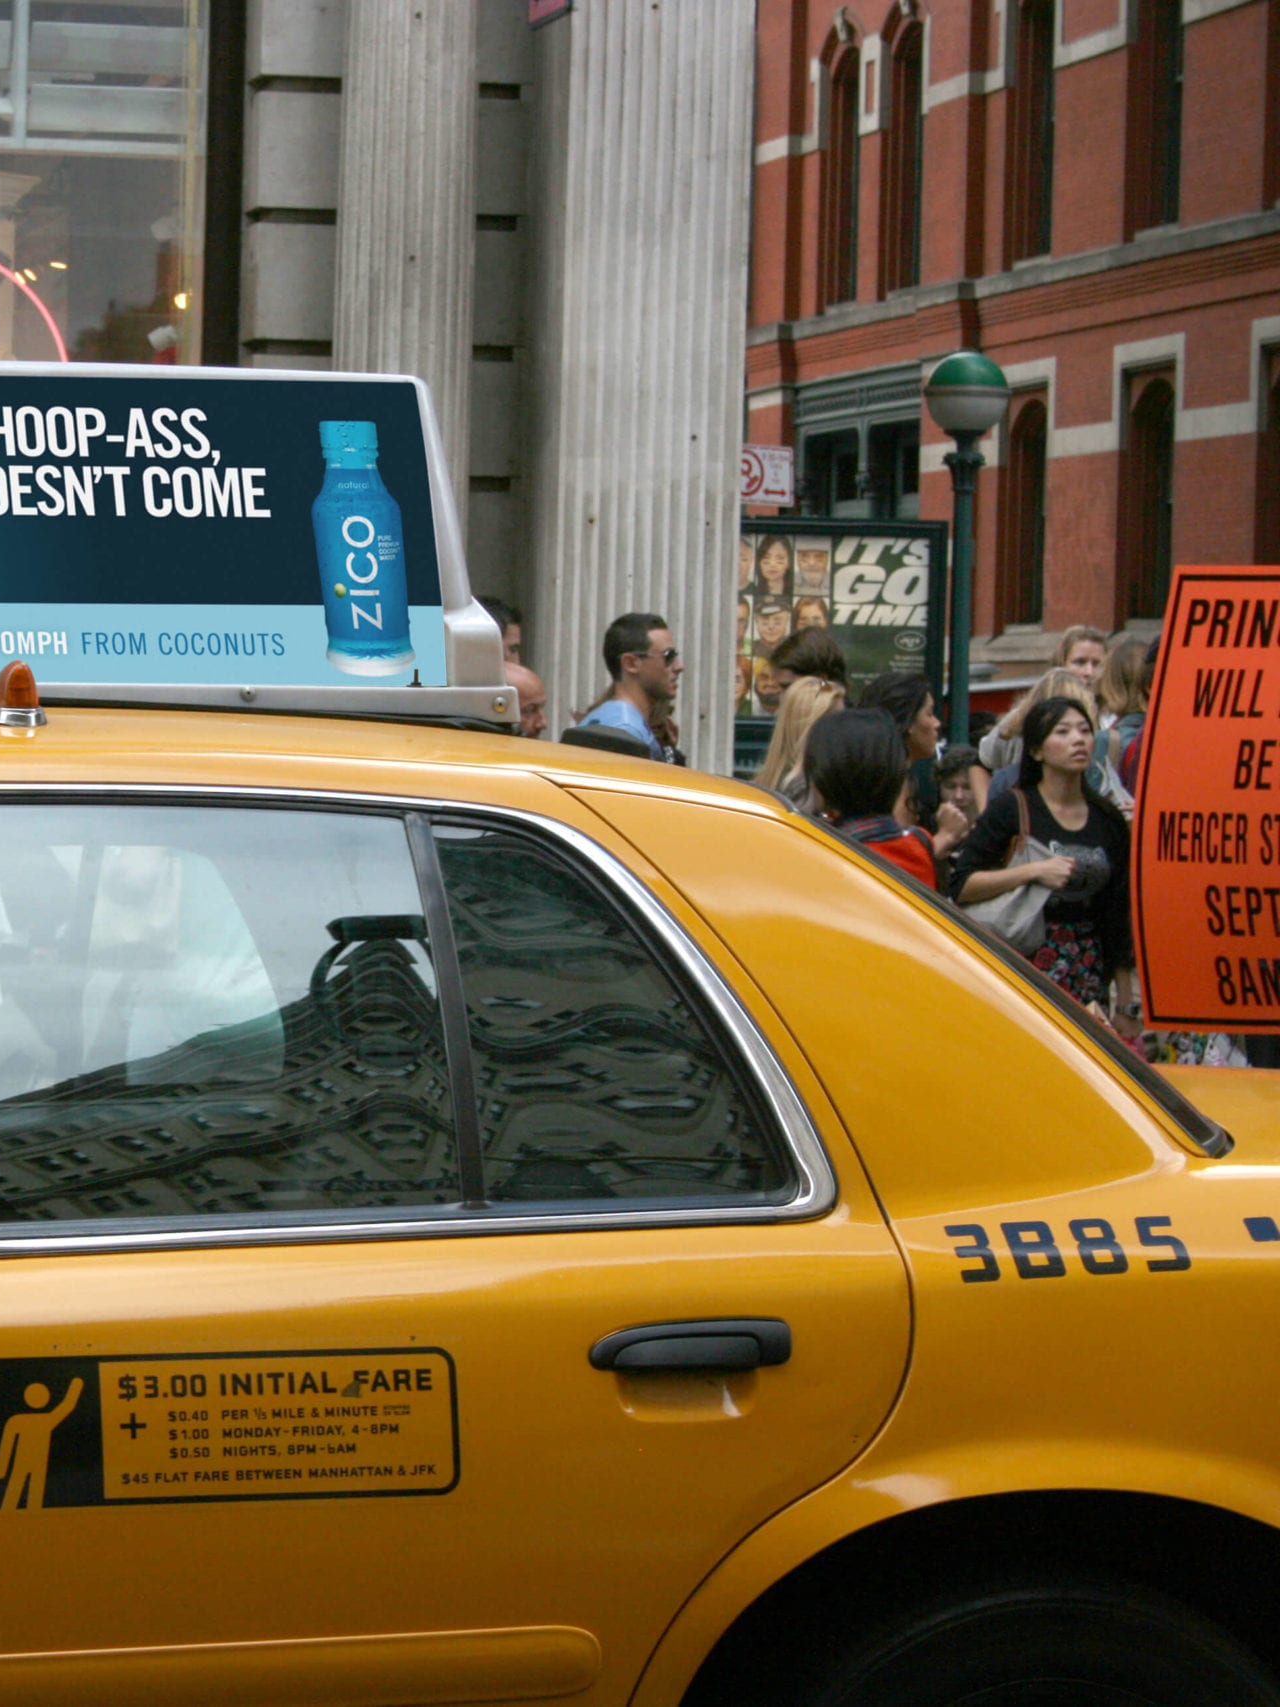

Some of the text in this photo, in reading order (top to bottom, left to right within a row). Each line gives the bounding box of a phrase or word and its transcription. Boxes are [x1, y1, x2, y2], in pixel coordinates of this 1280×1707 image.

[142, 467, 272, 518] COME
[834, 536, 930, 565] IT'S
[833, 563, 930, 606] GO
[831, 604, 929, 627] TIME
[1182, 599, 1280, 648] PRIN
[80, 631, 147, 656] FROM
[158, 631, 286, 657] COCONUTS
[1193, 669, 1264, 718] WILL
[1234, 739, 1280, 790] BE
[1157, 811, 1249, 864] MERCER
[118, 1368, 433, 1401] $3.00 INITIAL FARE
[168, 1410, 208, 1422] $0.40
[222, 1409, 250, 1421] PER
[272, 1407, 305, 1419] MILE
[310, 1406, 320, 1418] &
[324, 1405, 379, 1418] MINUTE
[168, 1428, 209, 1441] $1.00
[169, 1446, 210, 1459] $0.50
[223, 1445, 282, 1457] NIGHTS,
[121, 1463, 437, 1485] $45 FLAT FARE BETWEEN MANHATTAN & JFK
